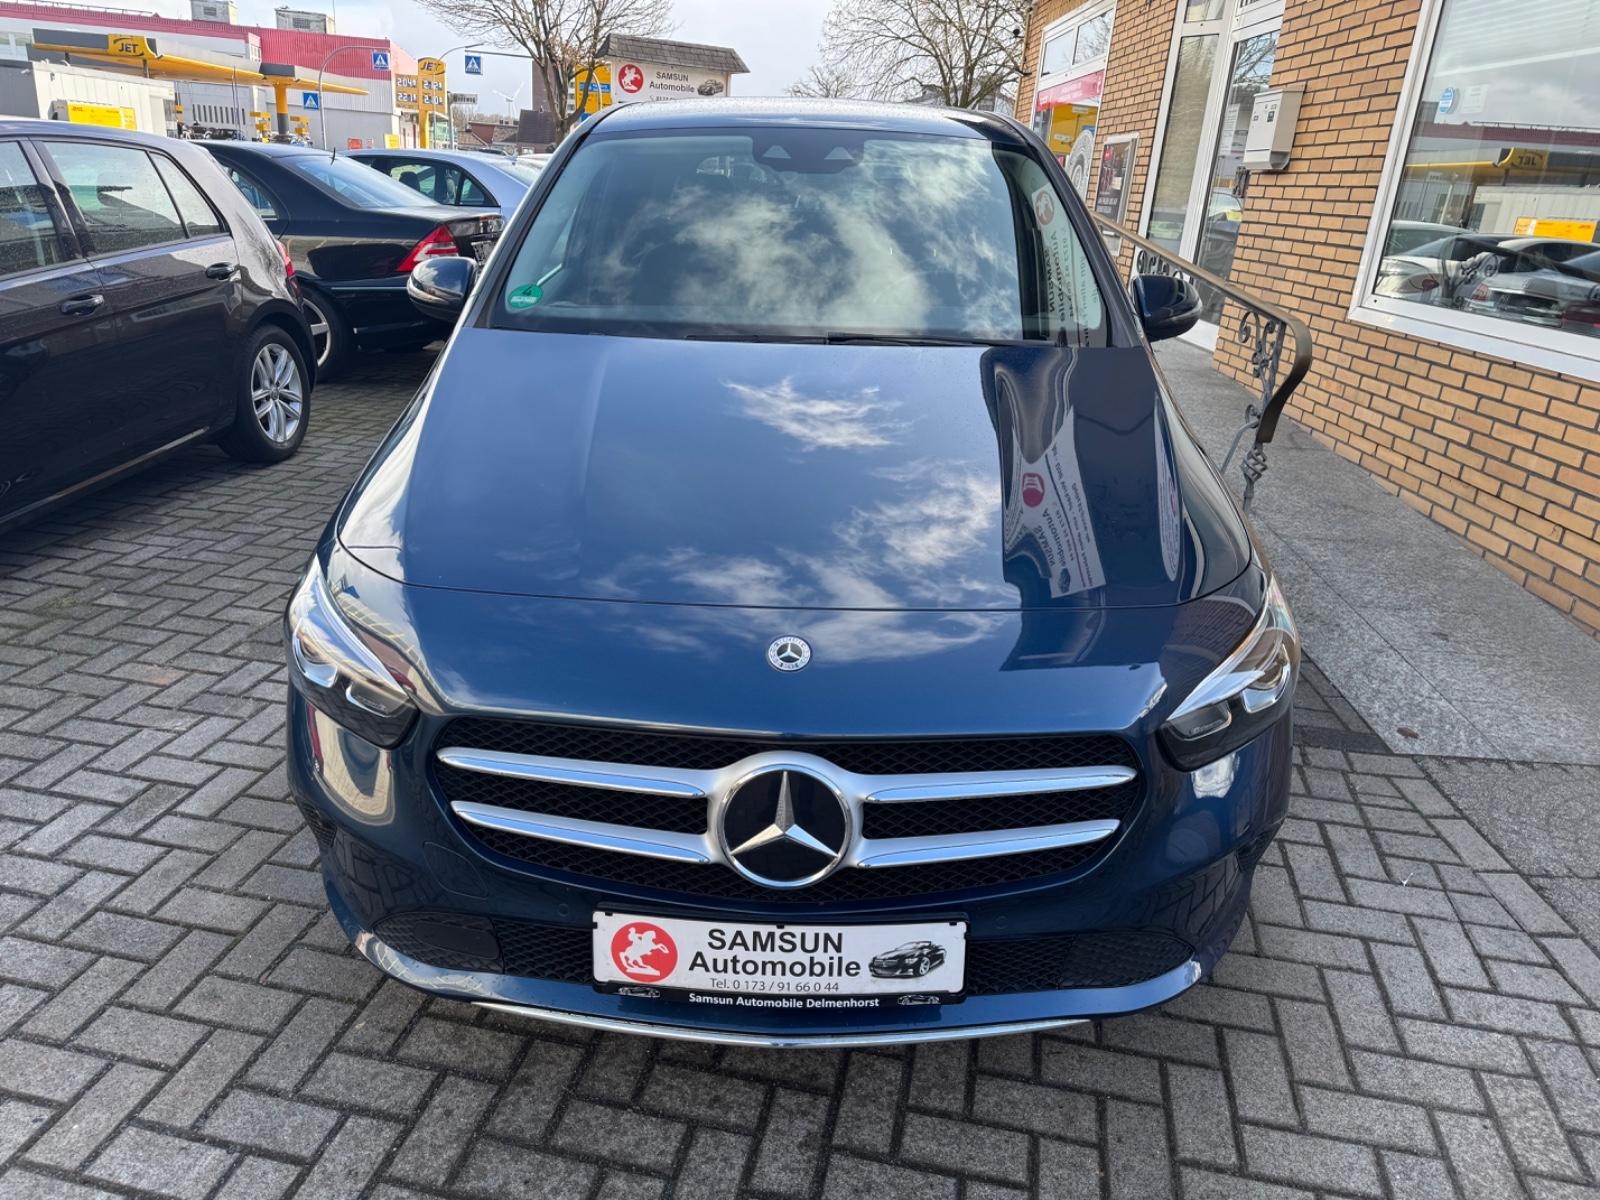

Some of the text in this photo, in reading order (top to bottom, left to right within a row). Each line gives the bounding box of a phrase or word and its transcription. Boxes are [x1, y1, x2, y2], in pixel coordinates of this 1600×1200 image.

[118, 43, 139, 53] JET
[420, 62, 441, 71] JET
[656, 71, 689, 82] SAMSUN
[649, 81, 695, 93] Automobile
[522, 286, 532, 296] 4
[707, 928, 843, 953] SAMSUN
[688, 951, 861, 977] Automobile
[710, 978, 730, 989] Tel.
[733, 980, 740, 990] 0
[744, 980, 765, 991] 173
[777, 981, 791, 992] 91
[795, 982, 811, 992] 66
[814, 982, 822, 992] 0
[825, 982, 840, 992] 44
[689, 993, 880, 1008] Samsun Automobile Delmenhorst
